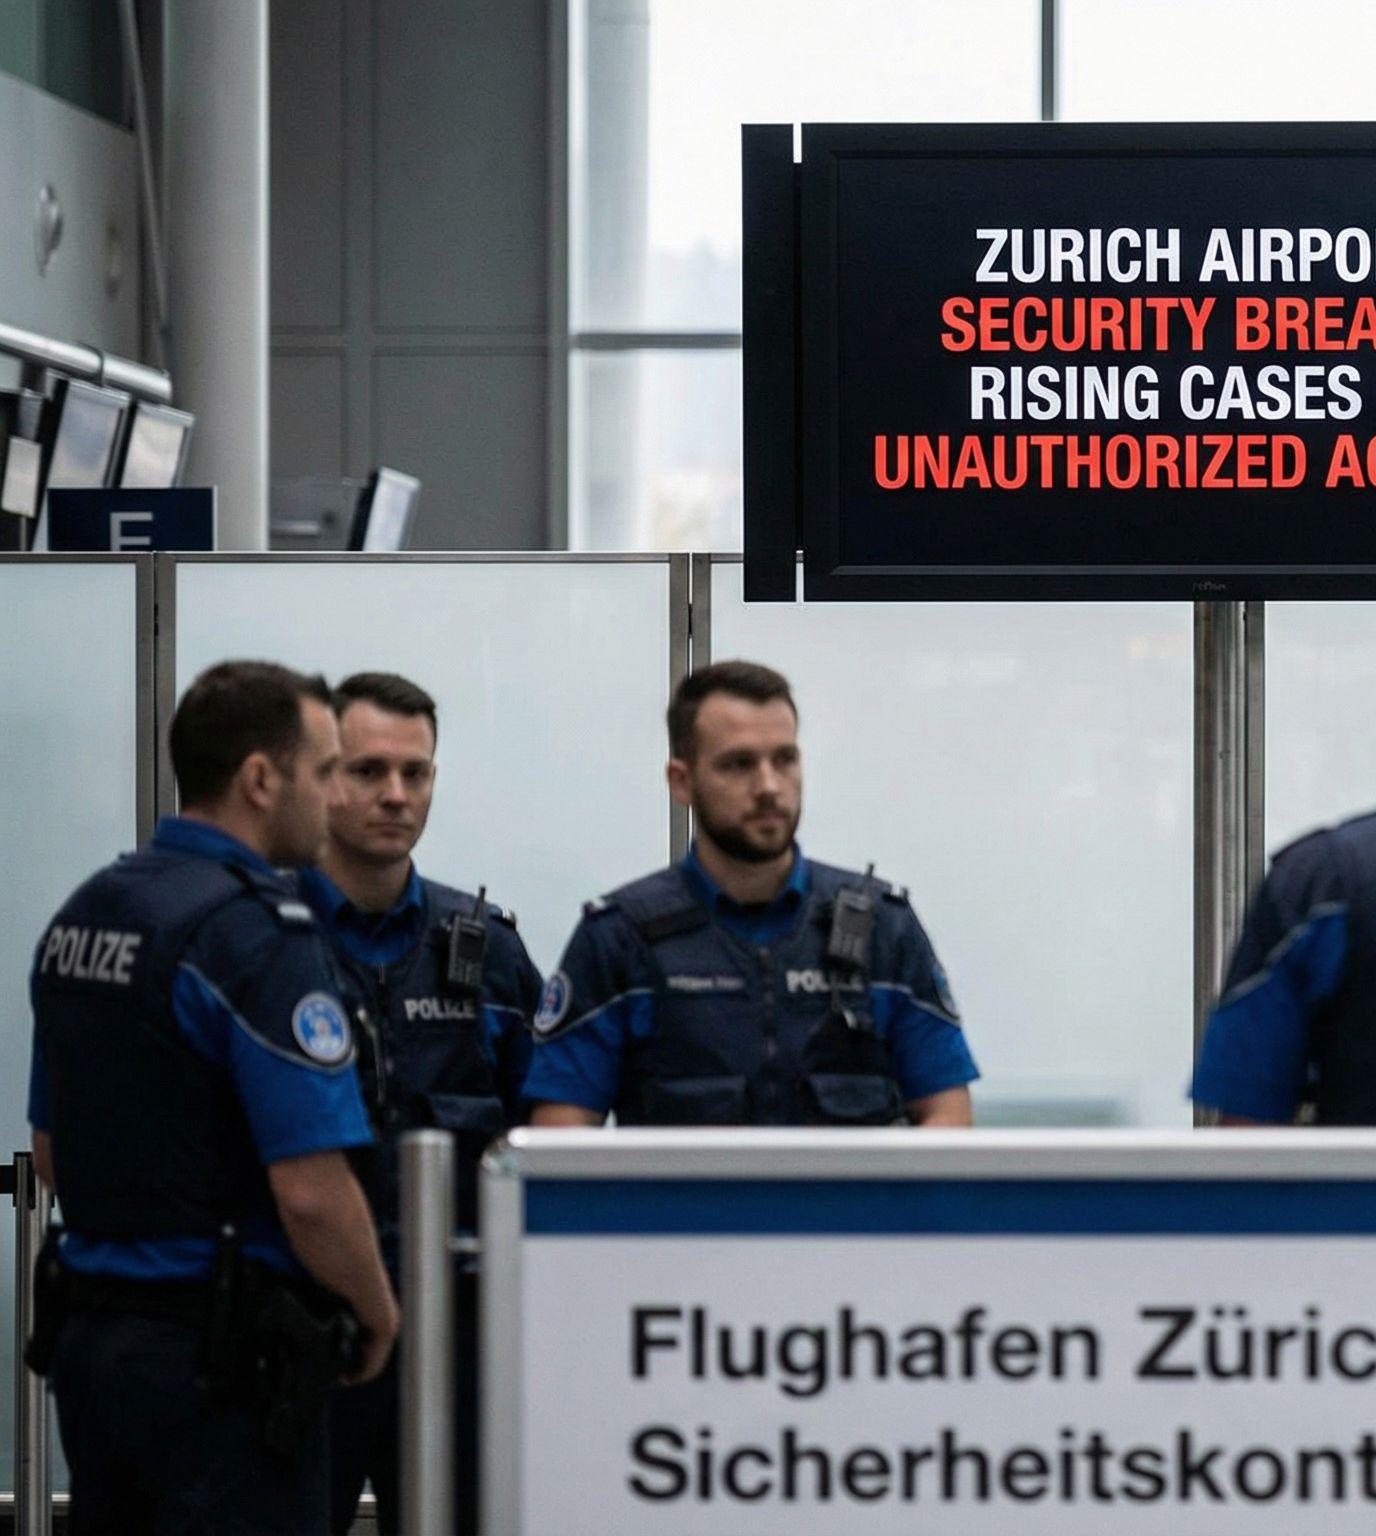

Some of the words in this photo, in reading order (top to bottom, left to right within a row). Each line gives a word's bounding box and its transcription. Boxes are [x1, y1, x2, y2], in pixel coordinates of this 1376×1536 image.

[975, 227, 1181, 284] ZURICH
[941, 296, 1217, 352] SECURITY
[970, 365, 1160, 421] RISING
[1179, 364, 1363, 421] CASES
[874, 434, 1307, 490] UNAUTHORIZED
[40, 926, 143, 985] POLIZE
[629, 1304, 1101, 1400] Flughafen
